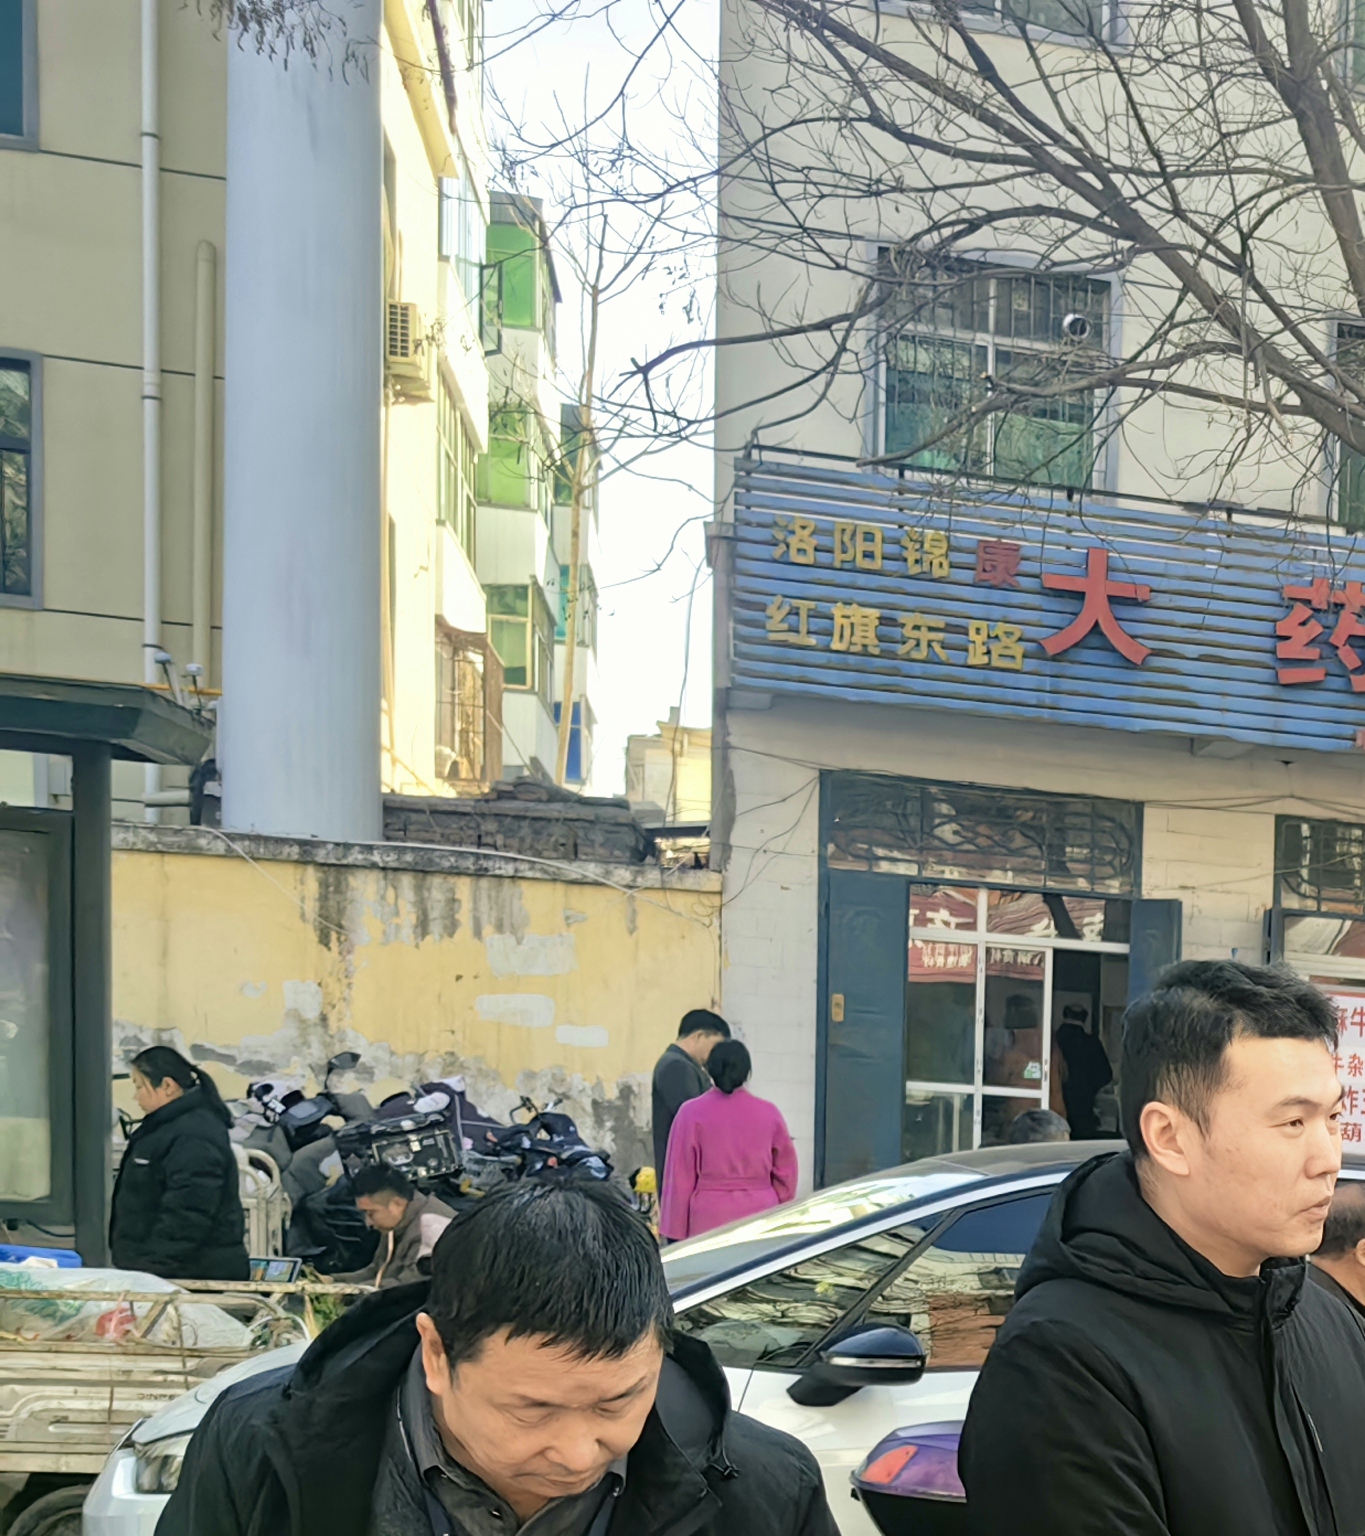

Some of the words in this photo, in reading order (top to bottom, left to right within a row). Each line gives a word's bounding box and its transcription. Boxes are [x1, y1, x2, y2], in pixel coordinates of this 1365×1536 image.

[771, 514, 1020, 588] 洛阳锦康
[766, 595, 1024, 670] 红旗东路
